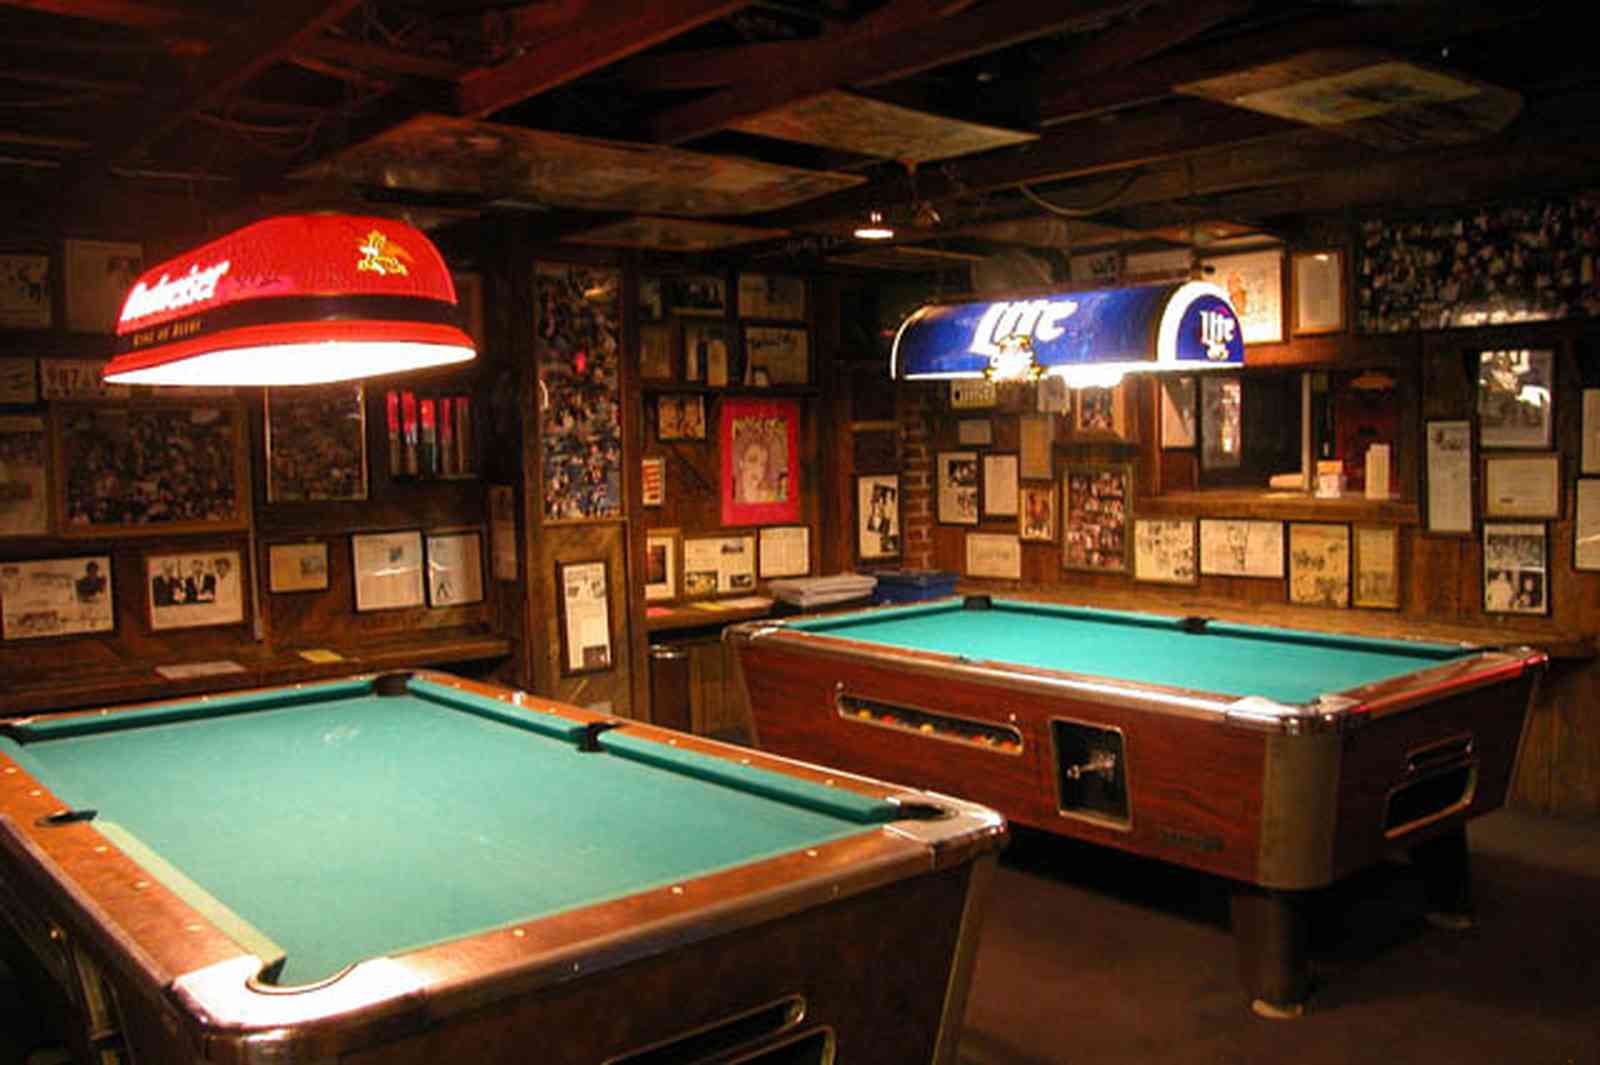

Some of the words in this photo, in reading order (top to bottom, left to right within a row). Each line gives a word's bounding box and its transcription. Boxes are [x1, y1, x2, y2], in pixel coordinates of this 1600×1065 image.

[120, 260, 230, 321] Budweiser
[967, 299, 1079, 356] Lite
[1199, 308, 1235, 344] Lite
